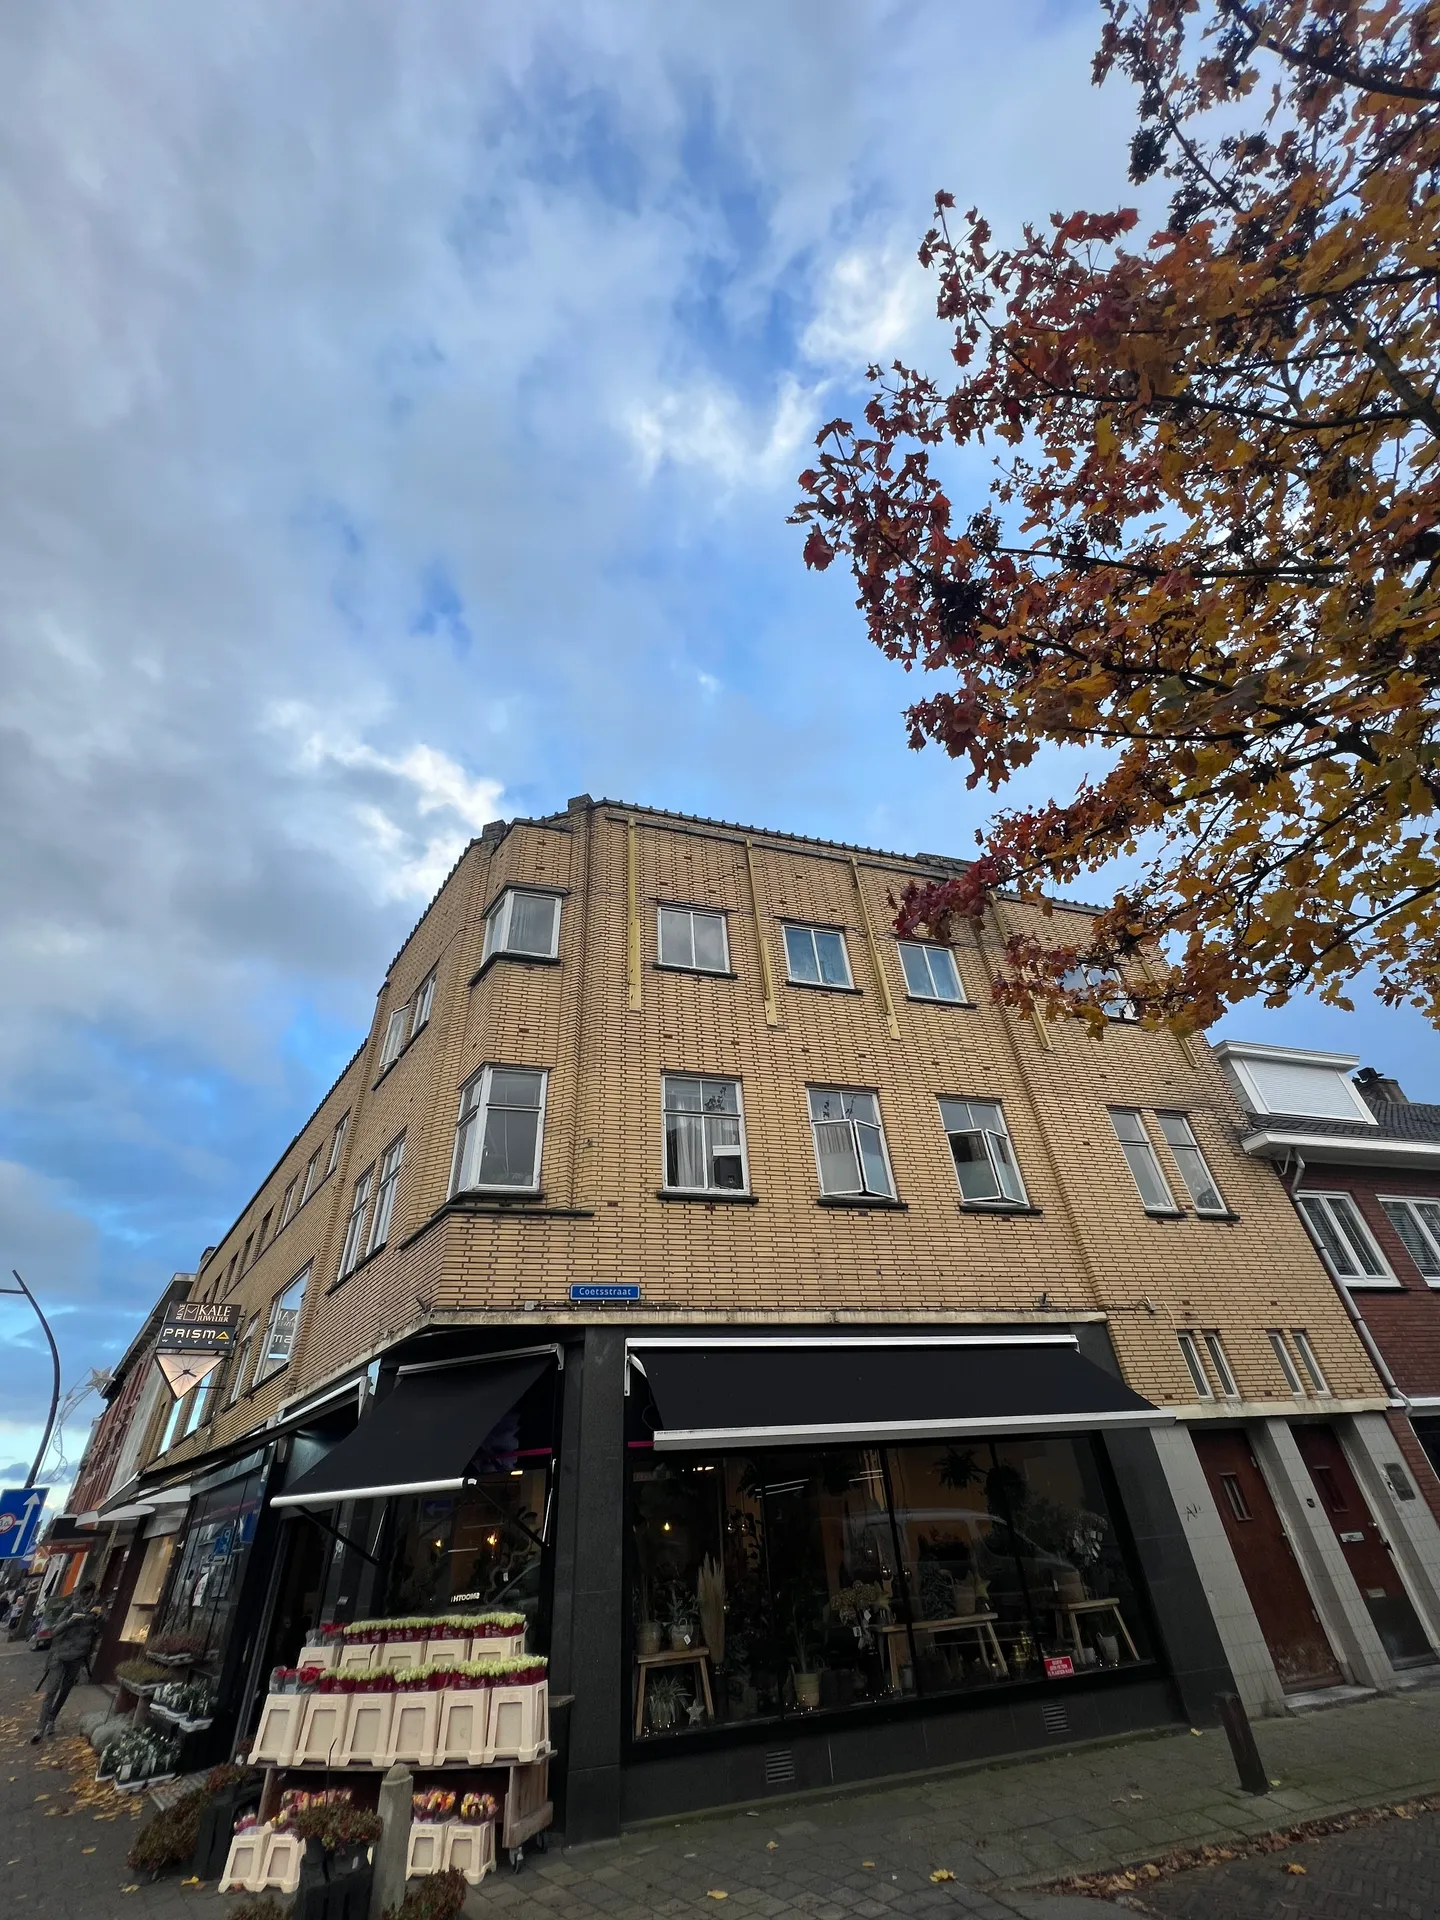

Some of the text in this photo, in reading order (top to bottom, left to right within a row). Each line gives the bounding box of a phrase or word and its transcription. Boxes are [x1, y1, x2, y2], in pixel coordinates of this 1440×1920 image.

[579, 1287, 631, 1296] Coetsstraat
[198, 1304, 232, 1317] KALE
[163, 1328, 230, 1340] PRISMA
